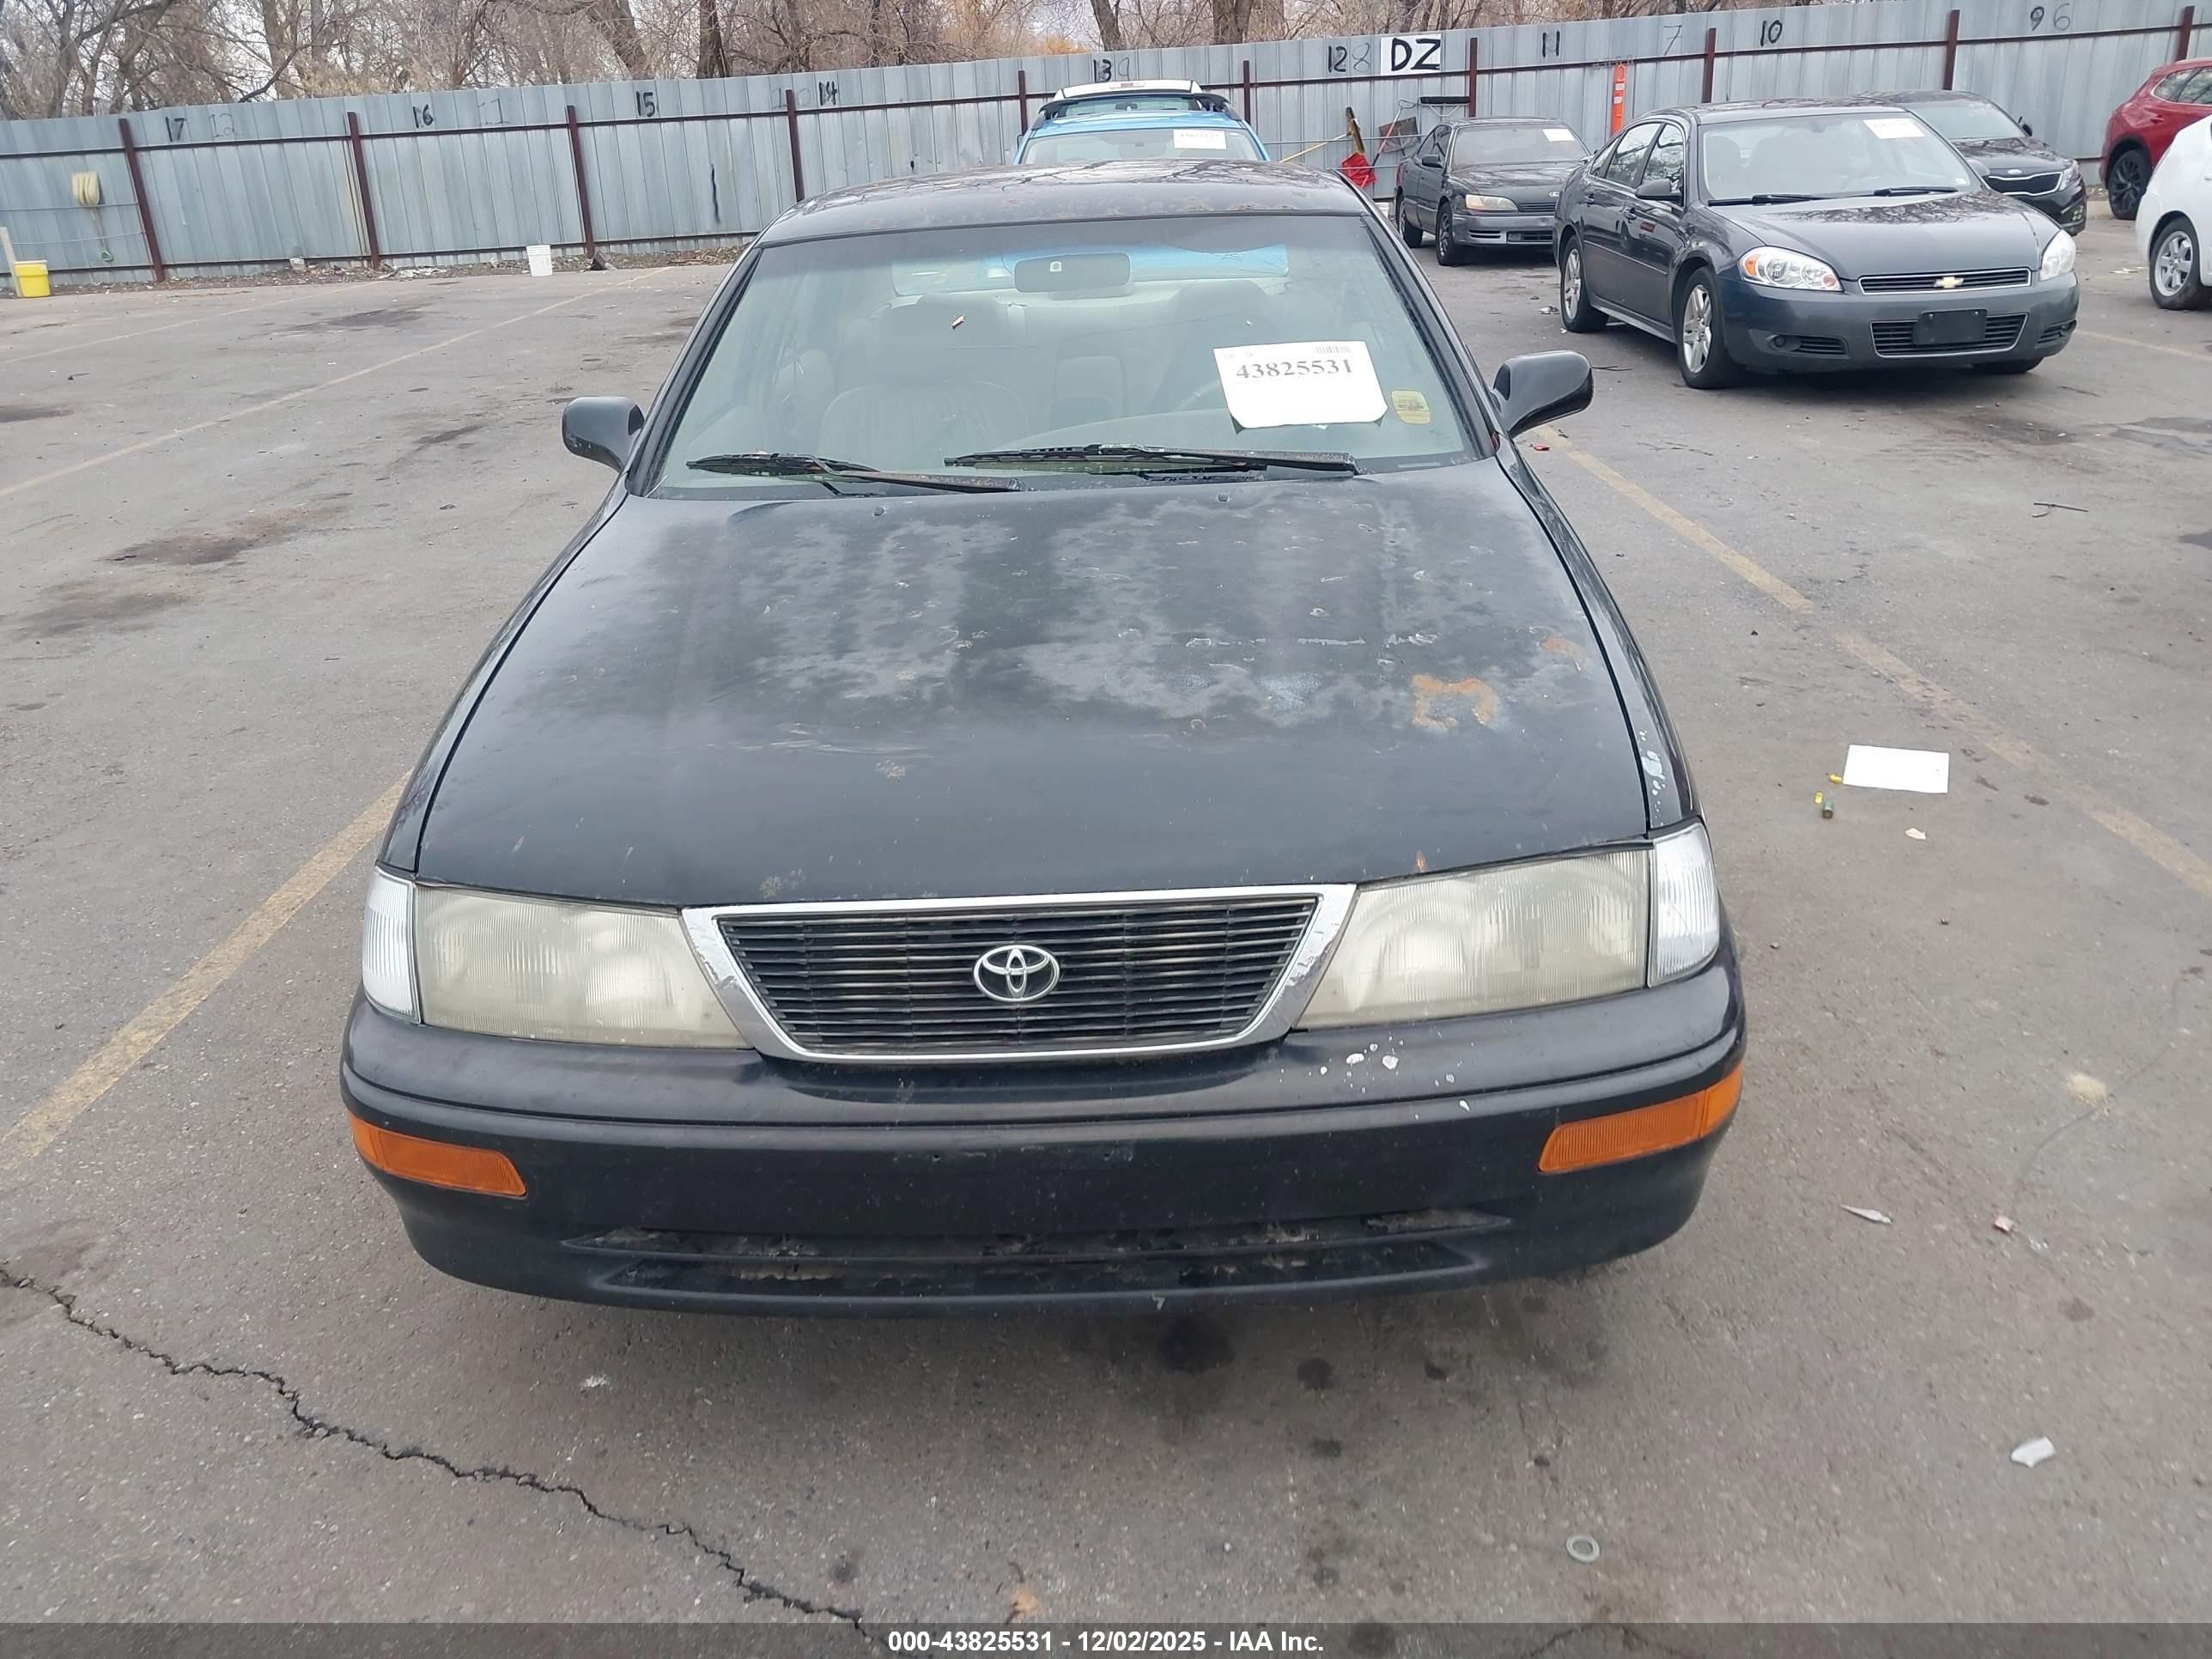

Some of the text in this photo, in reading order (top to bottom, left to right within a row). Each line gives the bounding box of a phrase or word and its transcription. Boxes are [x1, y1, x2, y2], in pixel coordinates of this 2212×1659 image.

[2030, 3, 2070, 31] 9 6
[1542, 30, 1560, 58] 11
[1760, 20, 1783, 46] 10
[1328, 42, 1370, 72] 12 8
[1391, 38, 1441, 71] DZ
[1093, 58, 1111, 83] 13
[636, 91, 655, 117] 15
[818, 81, 837, 106] 14
[166, 116, 186, 143] 17
[413, 104, 434, 129] 16
[1237, 359, 1352, 379] 43825531
